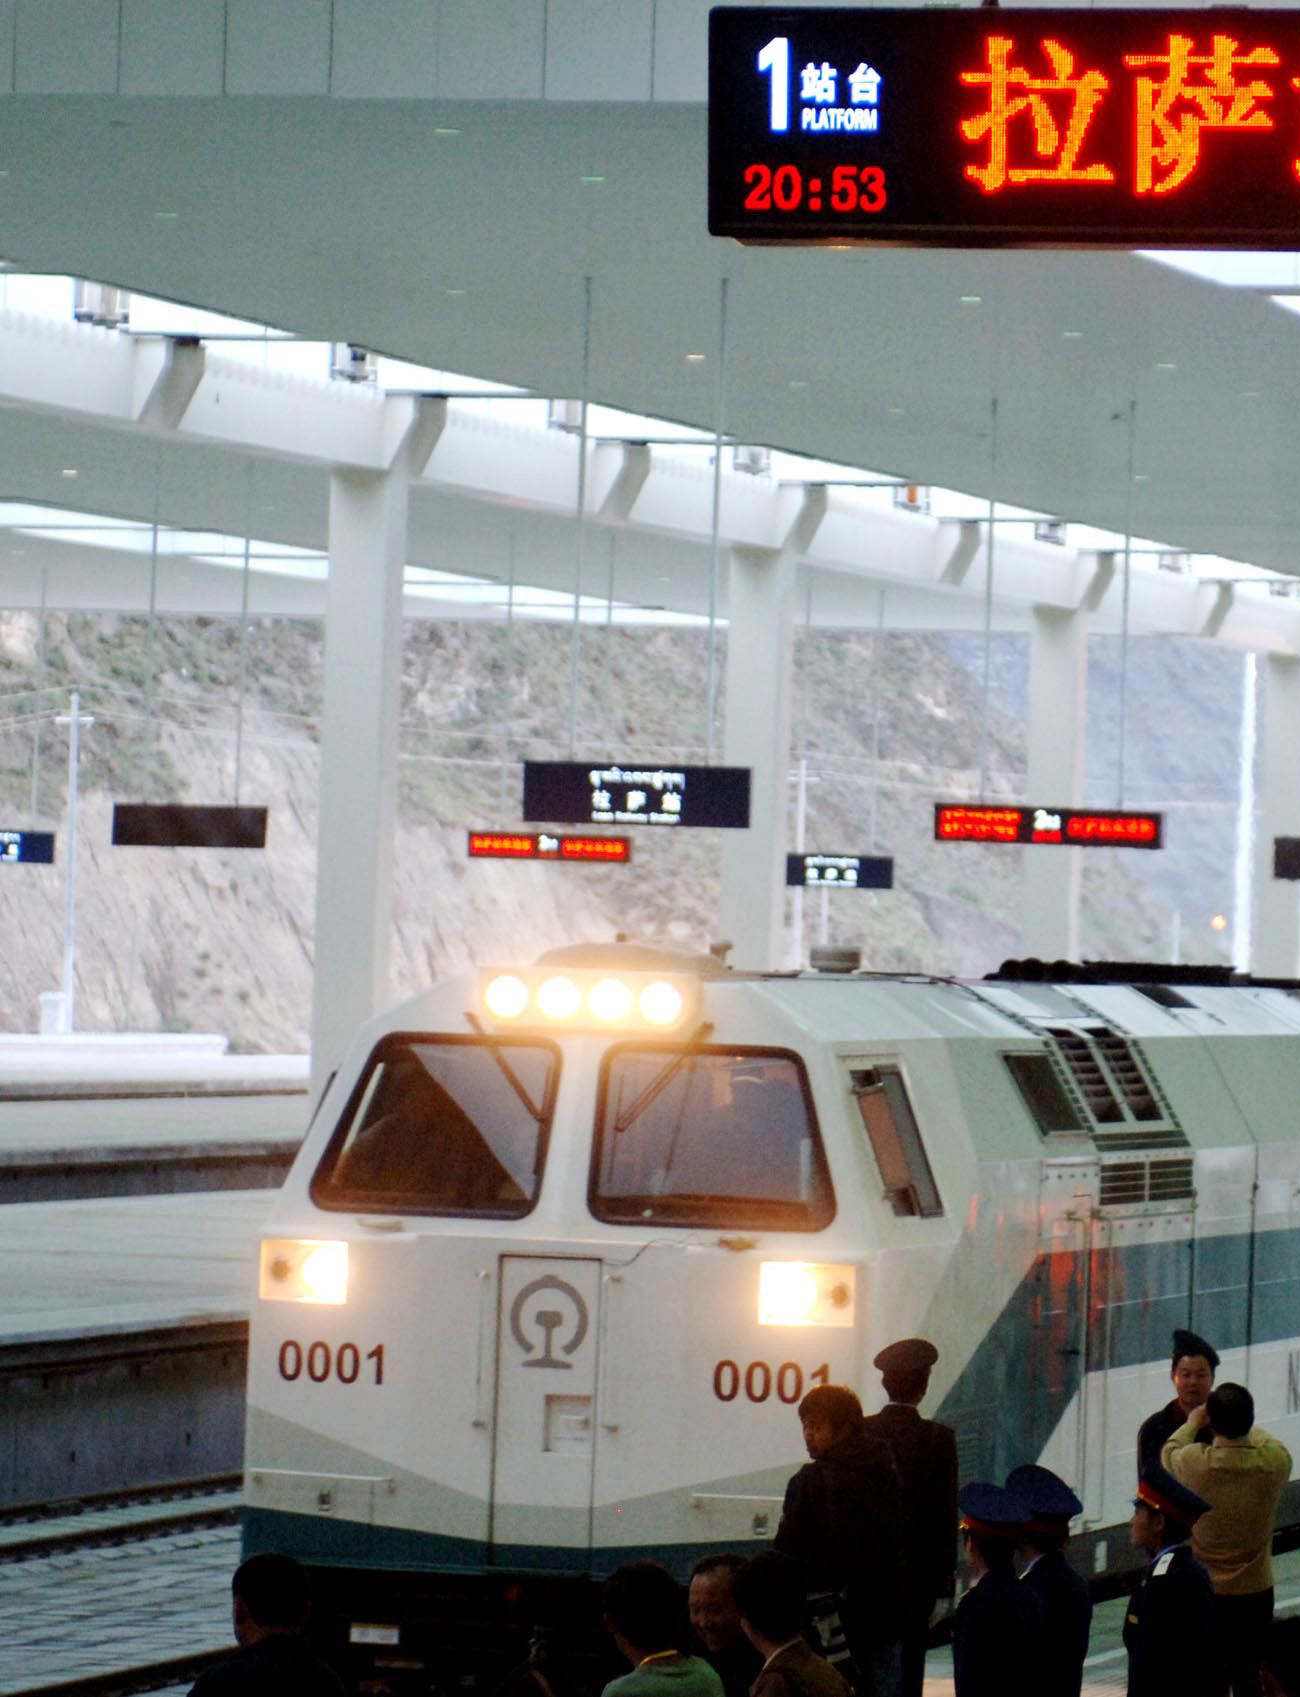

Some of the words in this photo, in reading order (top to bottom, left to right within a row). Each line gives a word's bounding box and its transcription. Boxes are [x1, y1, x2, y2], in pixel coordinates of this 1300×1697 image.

[758, 36, 789, 131] 1
[800, 62, 882, 103] 站台
[801, 107, 878, 131] PLATFORM
[744, 164, 887, 212] 20:53
[279, 1339, 384, 1385] 0001
